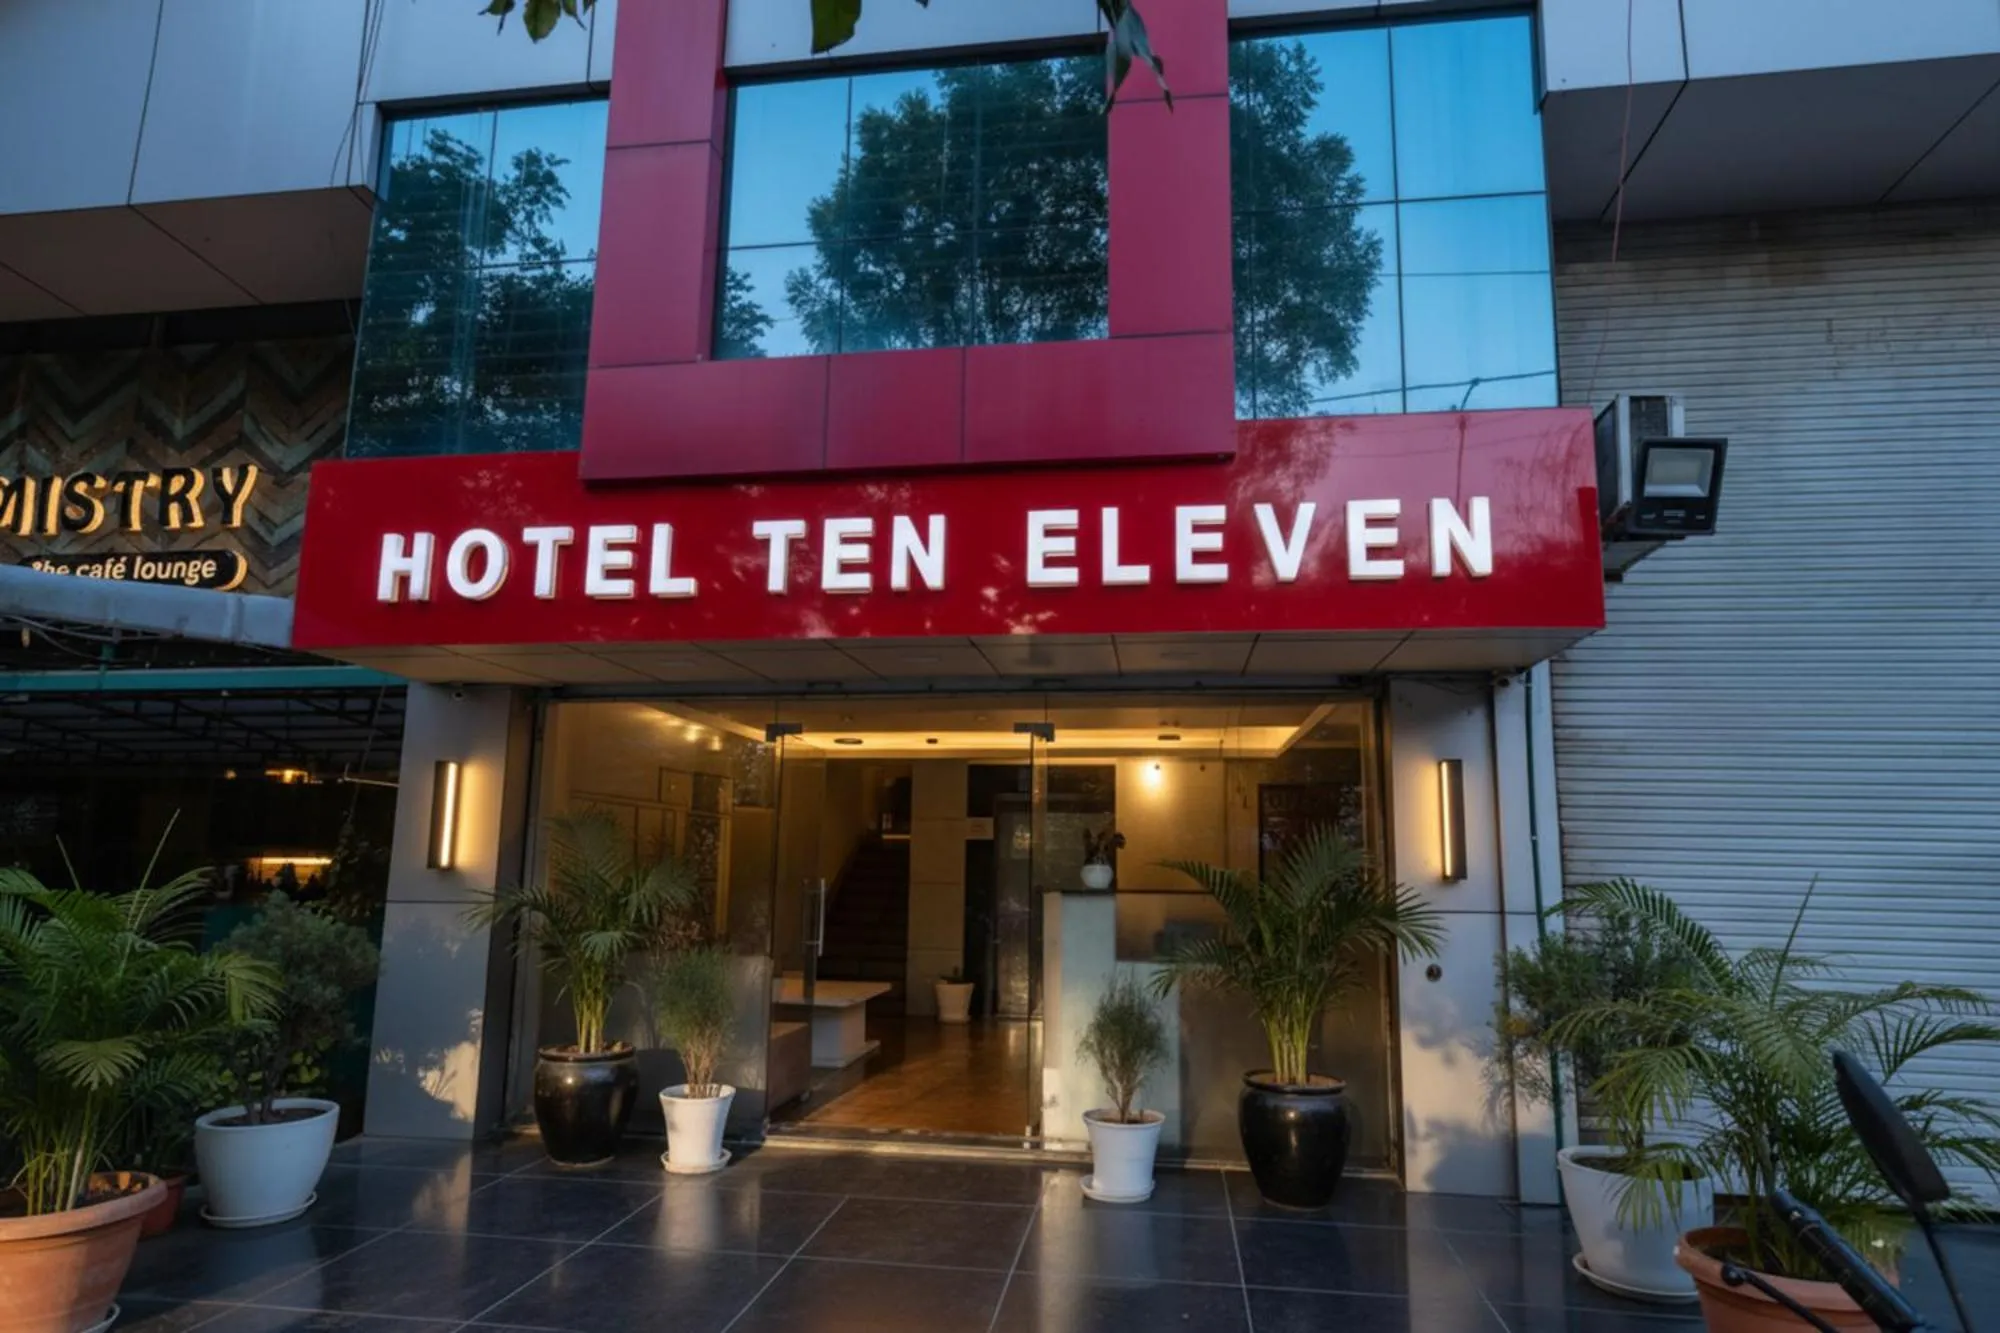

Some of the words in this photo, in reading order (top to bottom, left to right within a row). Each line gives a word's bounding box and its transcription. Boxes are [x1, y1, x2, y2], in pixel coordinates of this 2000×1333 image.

[75, 555, 126, 580] café
[133, 555, 217, 586] lounge
[377, 523, 698, 602] HOTEL
[752, 515, 946, 593] TEN
[1026, 496, 1493, 587] ELEVEN
